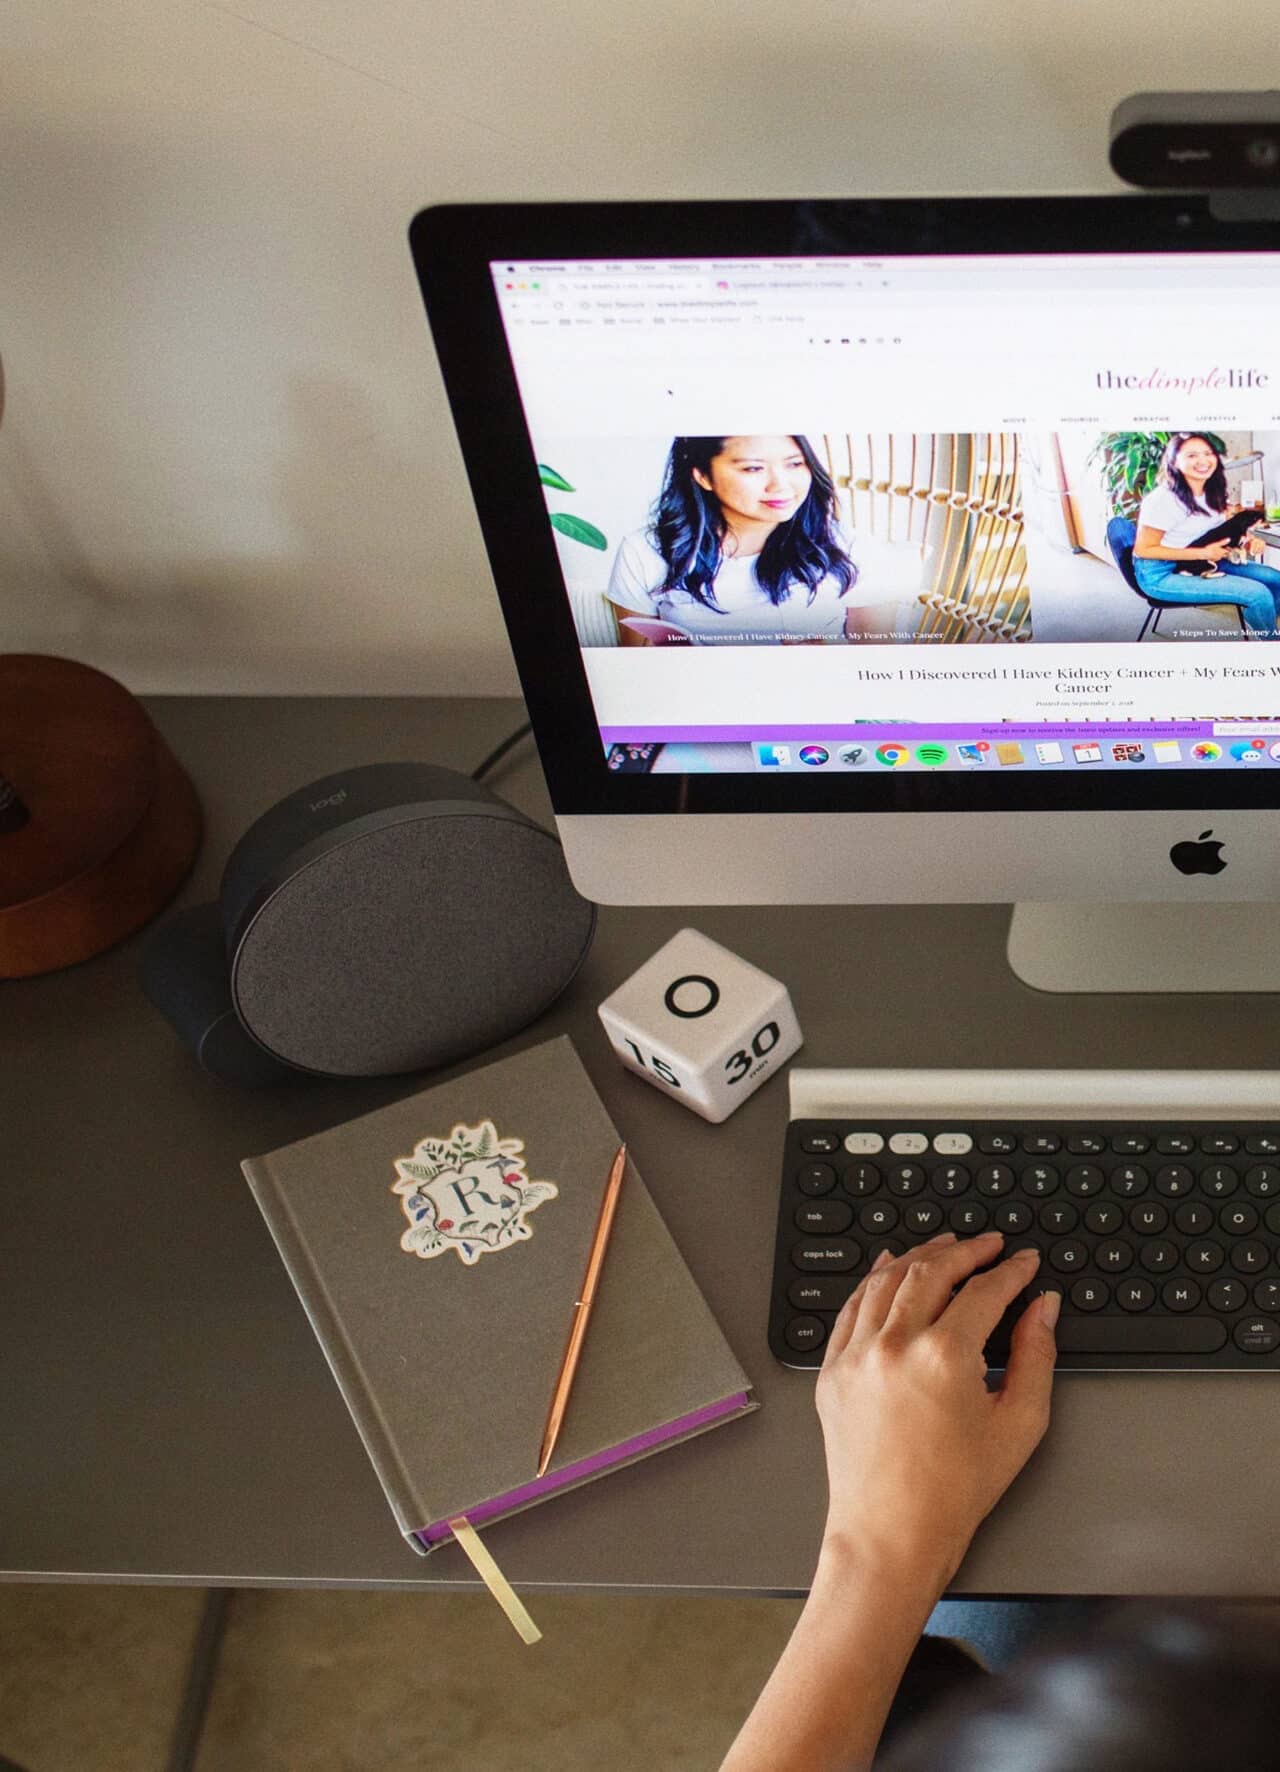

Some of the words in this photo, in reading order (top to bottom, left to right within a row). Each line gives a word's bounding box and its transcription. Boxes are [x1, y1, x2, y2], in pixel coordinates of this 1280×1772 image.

[1096, 367, 1269, 396] thedimplelife
[667, 633, 688, 641] How
[696, 633, 743, 641] Discovered
[775, 633, 802, 642] Kidney
[806, 632, 838, 640] Cancer
[848, 633, 863, 642] My
[864, 632, 889, 640] Fears
[912, 631, 944, 639] Cancer
[1179, 629, 1204, 638] Steps
[1205, 629, 1217, 637] To
[1240, 629, 1270, 638] Money
[858, 670, 894, 681] How
[899, 669, 904, 680] I
[909, 668, 997, 681] Discovered
[1002, 669, 1007, 680] I
[1012, 668, 1052, 679] Have
[1057, 667, 1112, 681] Kidney
[1117, 666, 1174, 679] Cancer
[1194, 666, 1217, 681] My
[1223, 666, 1266, 678] Fears
[1055, 682, 1112, 693] Cancer
[725, 1021, 781, 1085] 30
[625, 1038, 681, 1088] 15
[947, 1182, 954, 1190] 3
[992, 1182, 999, 1190] 4
[1037, 1182, 1043, 1190] 5
[1081, 1182, 1088, 1190] 6
[1126, 1182, 1132, 1190] 7
[1171, 1182, 1178, 1190] 8
[1215, 1182, 1222, 1191] 9
[1260, 1182, 1268, 1191] 0
[448, 1176, 501, 1218] R
[807, 1213, 822, 1221] tab
[873, 1212, 885, 1222] Q
[917, 1212, 931, 1222] W
[965, 1212, 973, 1222] E
[1009, 1213, 1018, 1222] R
[1055, 1213, 1064, 1222] T
[1099, 1213, 1108, 1223] Y
[1143, 1213, 1153, 1223] U
[1233, 1213, 1244, 1223] O
[803, 1250, 824, 1259] caps
[826, 1249, 844, 1258] lock
[1064, 1252, 1074, 1261] G
[1109, 1252, 1119, 1261] H
[1156, 1252, 1163, 1262] J
[1200, 1252, 1209, 1262] K
[1247, 1252, 1255, 1262] L
[800, 1288, 821, 1297] shift
[1086, 1290, 1094, 1300] B
[1131, 1290, 1140, 1300] N
[1176, 1290, 1187, 1300] M
[798, 1328, 814, 1337] ctrl
[1251, 1324, 1264, 1332] alt
